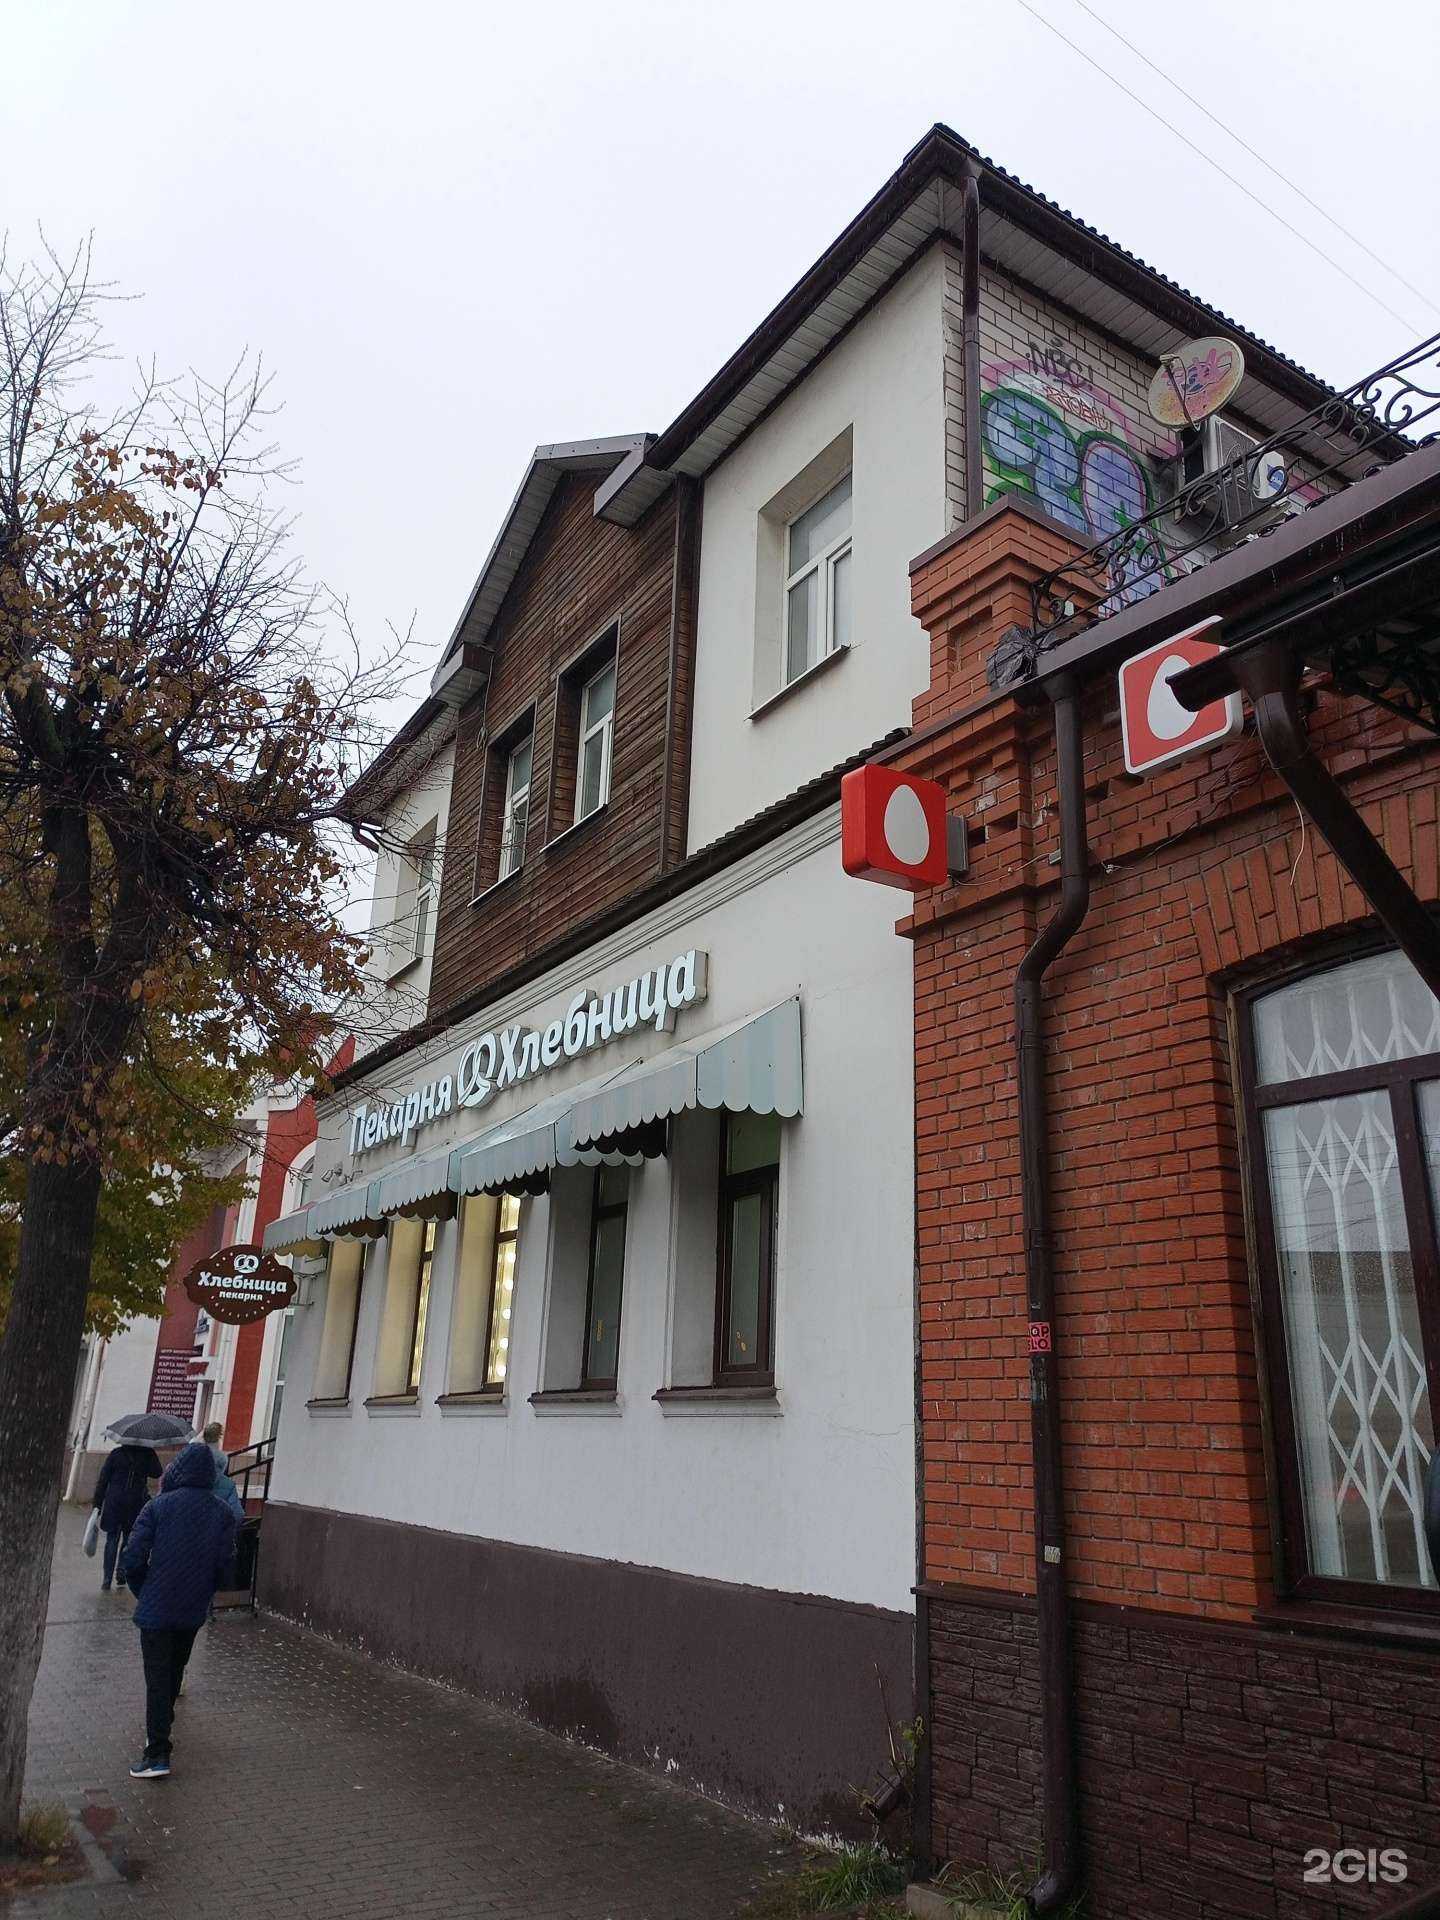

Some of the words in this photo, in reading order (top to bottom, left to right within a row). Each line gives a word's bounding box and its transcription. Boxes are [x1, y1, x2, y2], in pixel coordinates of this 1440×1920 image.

[349, 1074, 453, 1155] Пекарня
[497, 949, 705, 1087] Хлебница
[198, 1271, 287, 1295] Хлебница
[219, 1290, 263, 1302] пекарня
